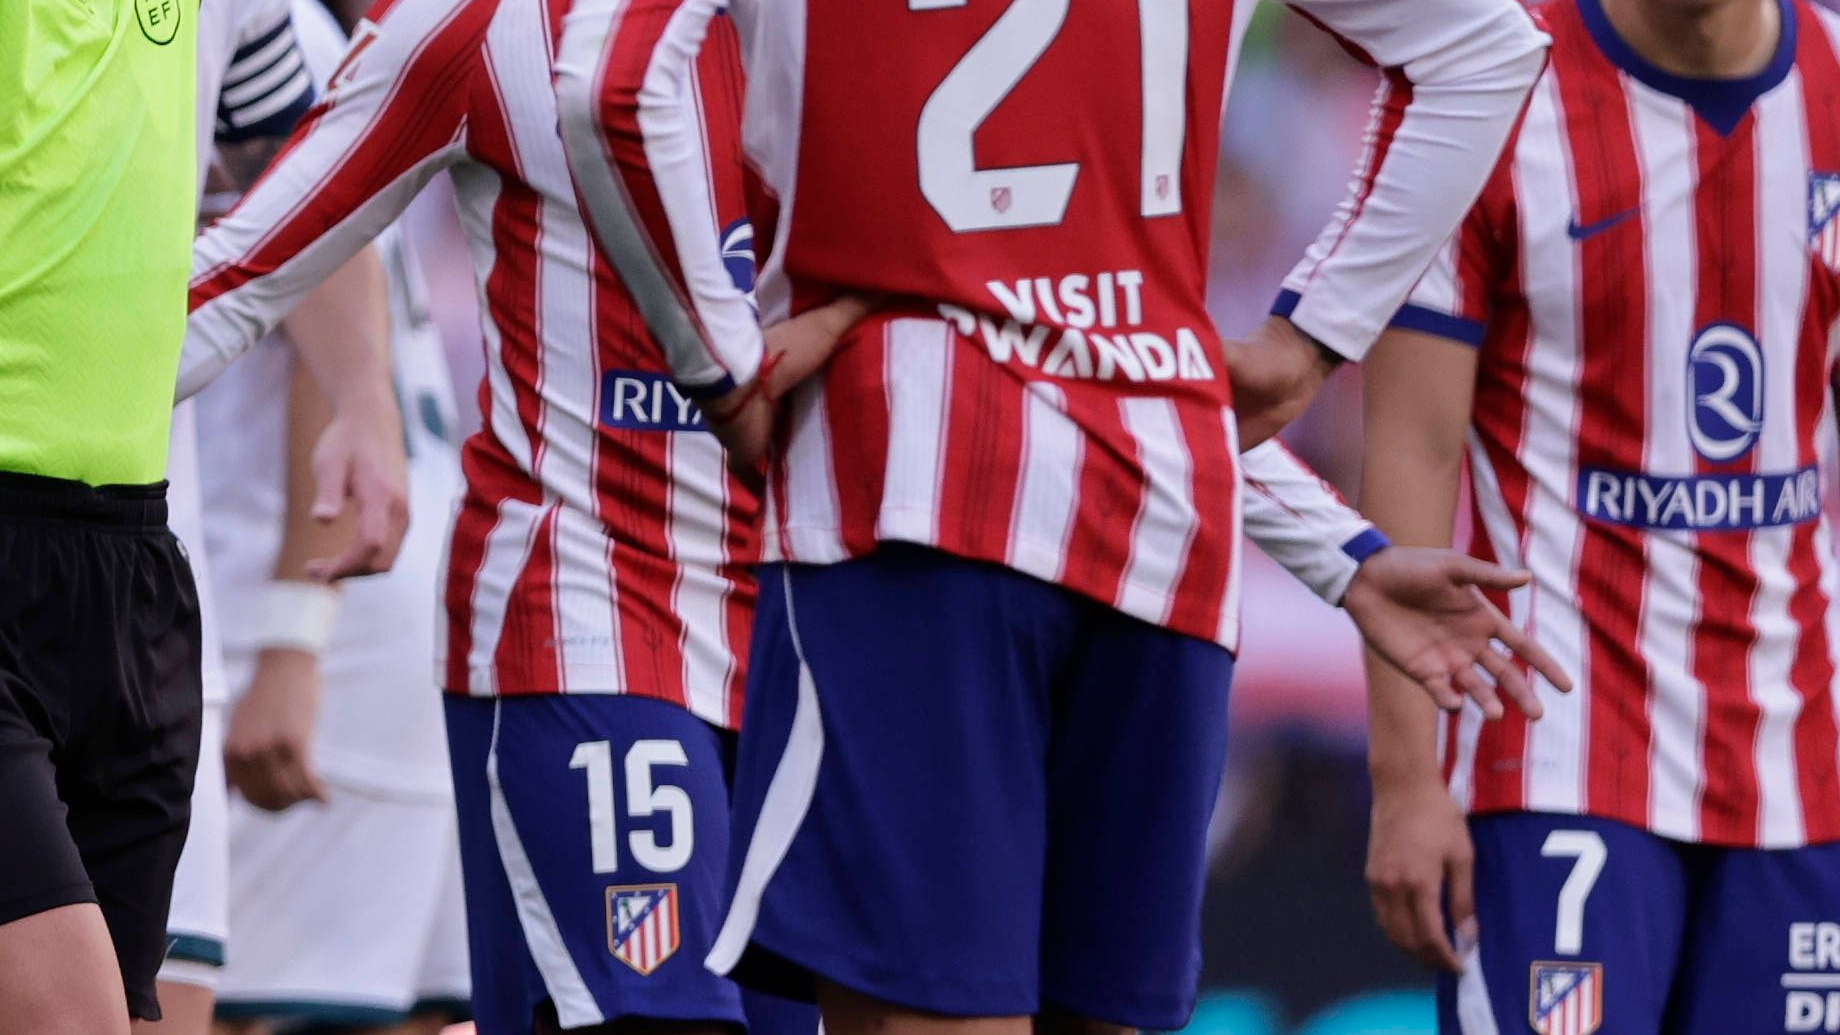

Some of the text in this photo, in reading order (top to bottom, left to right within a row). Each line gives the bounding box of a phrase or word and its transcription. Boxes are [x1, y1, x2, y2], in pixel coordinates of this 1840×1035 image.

[985, 270, 1143, 329] VISIT
[612, 376, 702, 426] RIY
[1586, 468, 1820, 527] RIYADH AIR
[568, 739, 694, 874] 15
[1540, 829, 1608, 956] 7
